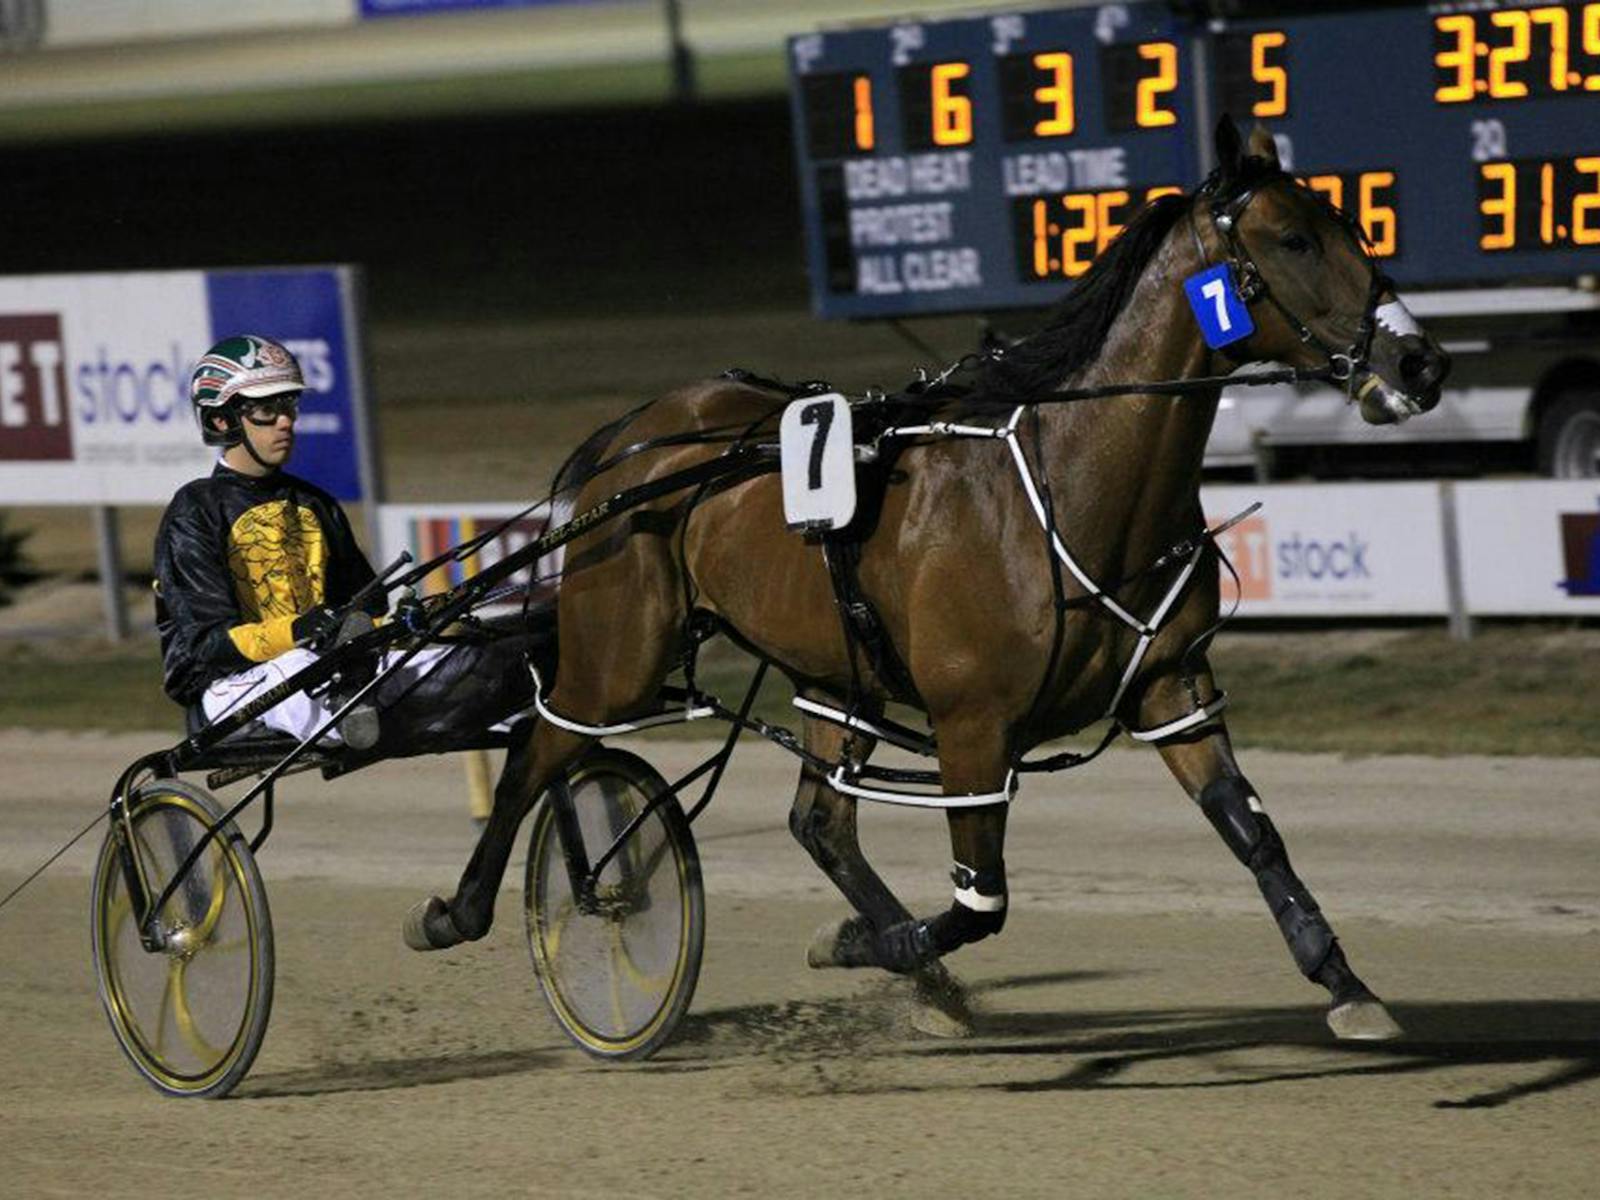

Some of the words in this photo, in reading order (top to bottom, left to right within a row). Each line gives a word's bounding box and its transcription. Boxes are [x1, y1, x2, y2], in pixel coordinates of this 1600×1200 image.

[854, 76, 874, 150] 1
[931, 62, 972, 146] 6
[1033, 52, 1074, 136] 3
[1136, 42, 1177, 127] 2
[1252, 32, 1287, 117] 5
[909, 151, 971, 194] HEAT
[1003, 152, 1069, 195] LEAD
[1069, 148, 1128, 189] TIME
[850, 202, 952, 245] PROTEST
[857, 255, 902, 294] ALL
[902, 248, 982, 291] CLEAR
[1201, 278, 1231, 332] 7
[801, 400, 834, 490] 7
[1277, 530, 1372, 580] stock
